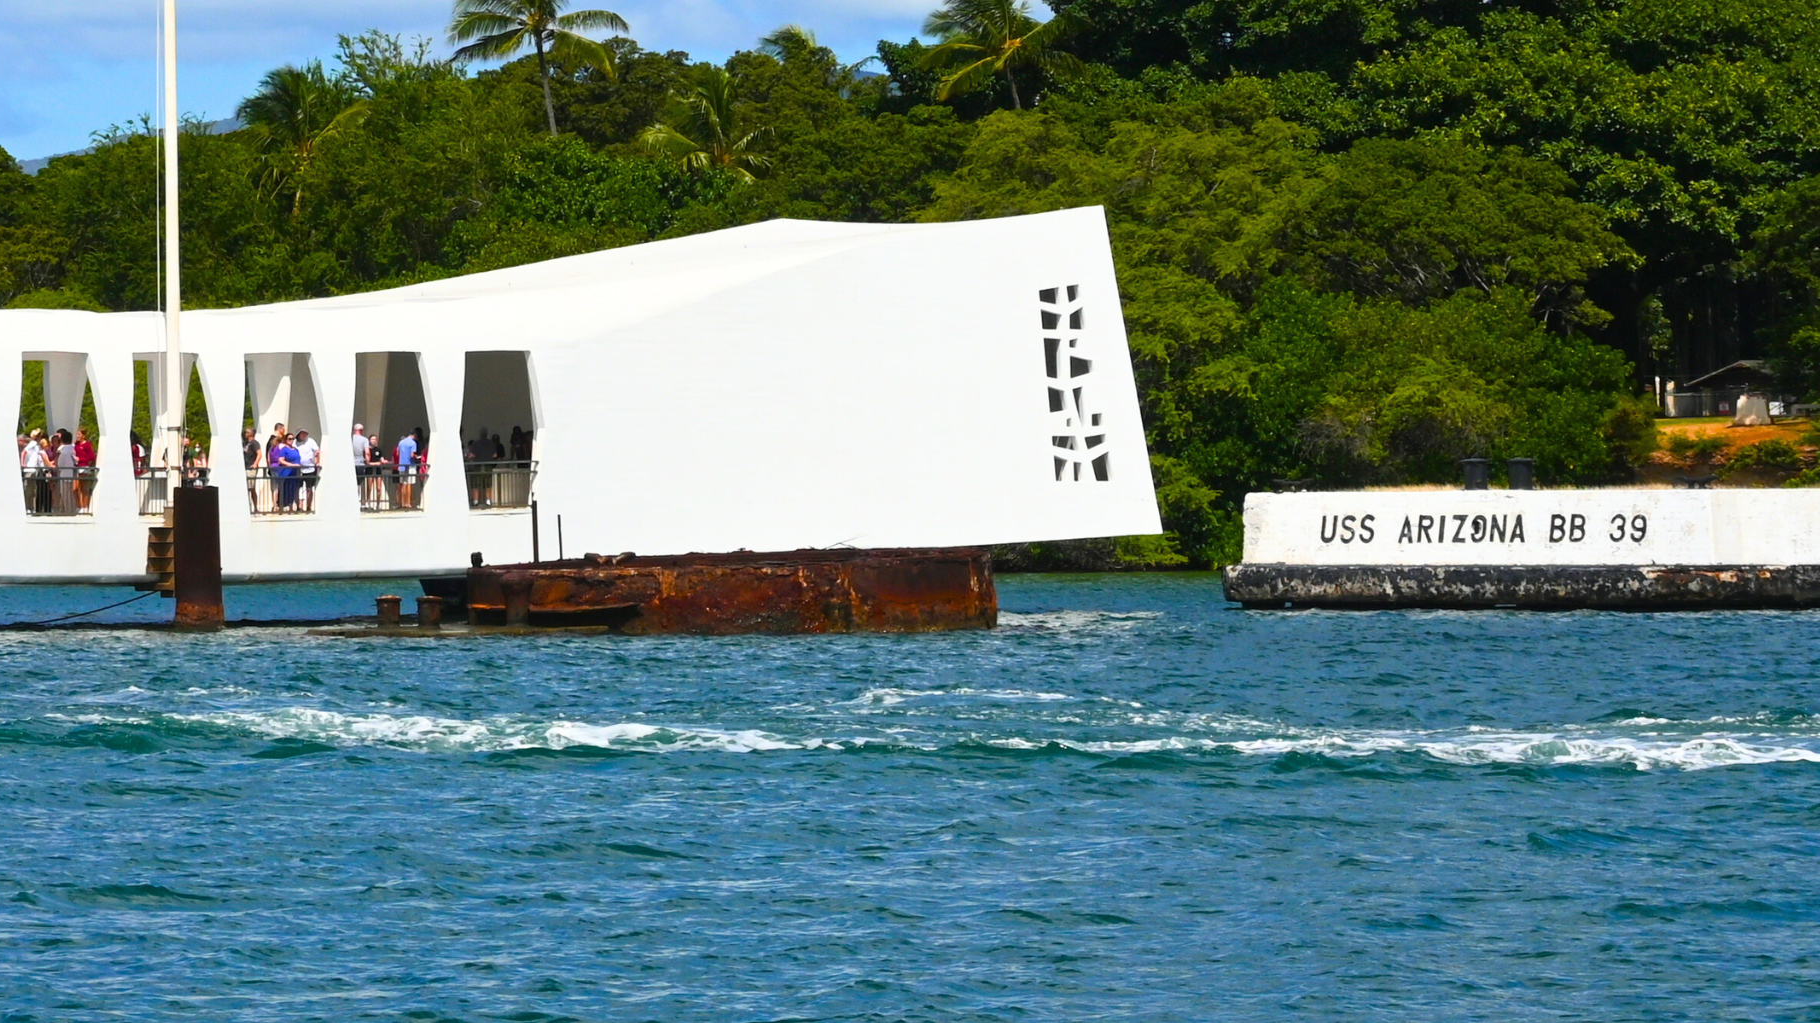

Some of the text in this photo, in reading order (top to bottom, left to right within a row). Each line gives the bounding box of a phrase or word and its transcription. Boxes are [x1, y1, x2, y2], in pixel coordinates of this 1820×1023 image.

[1320, 513, 1647, 544] USS ARIZONA BB 39
